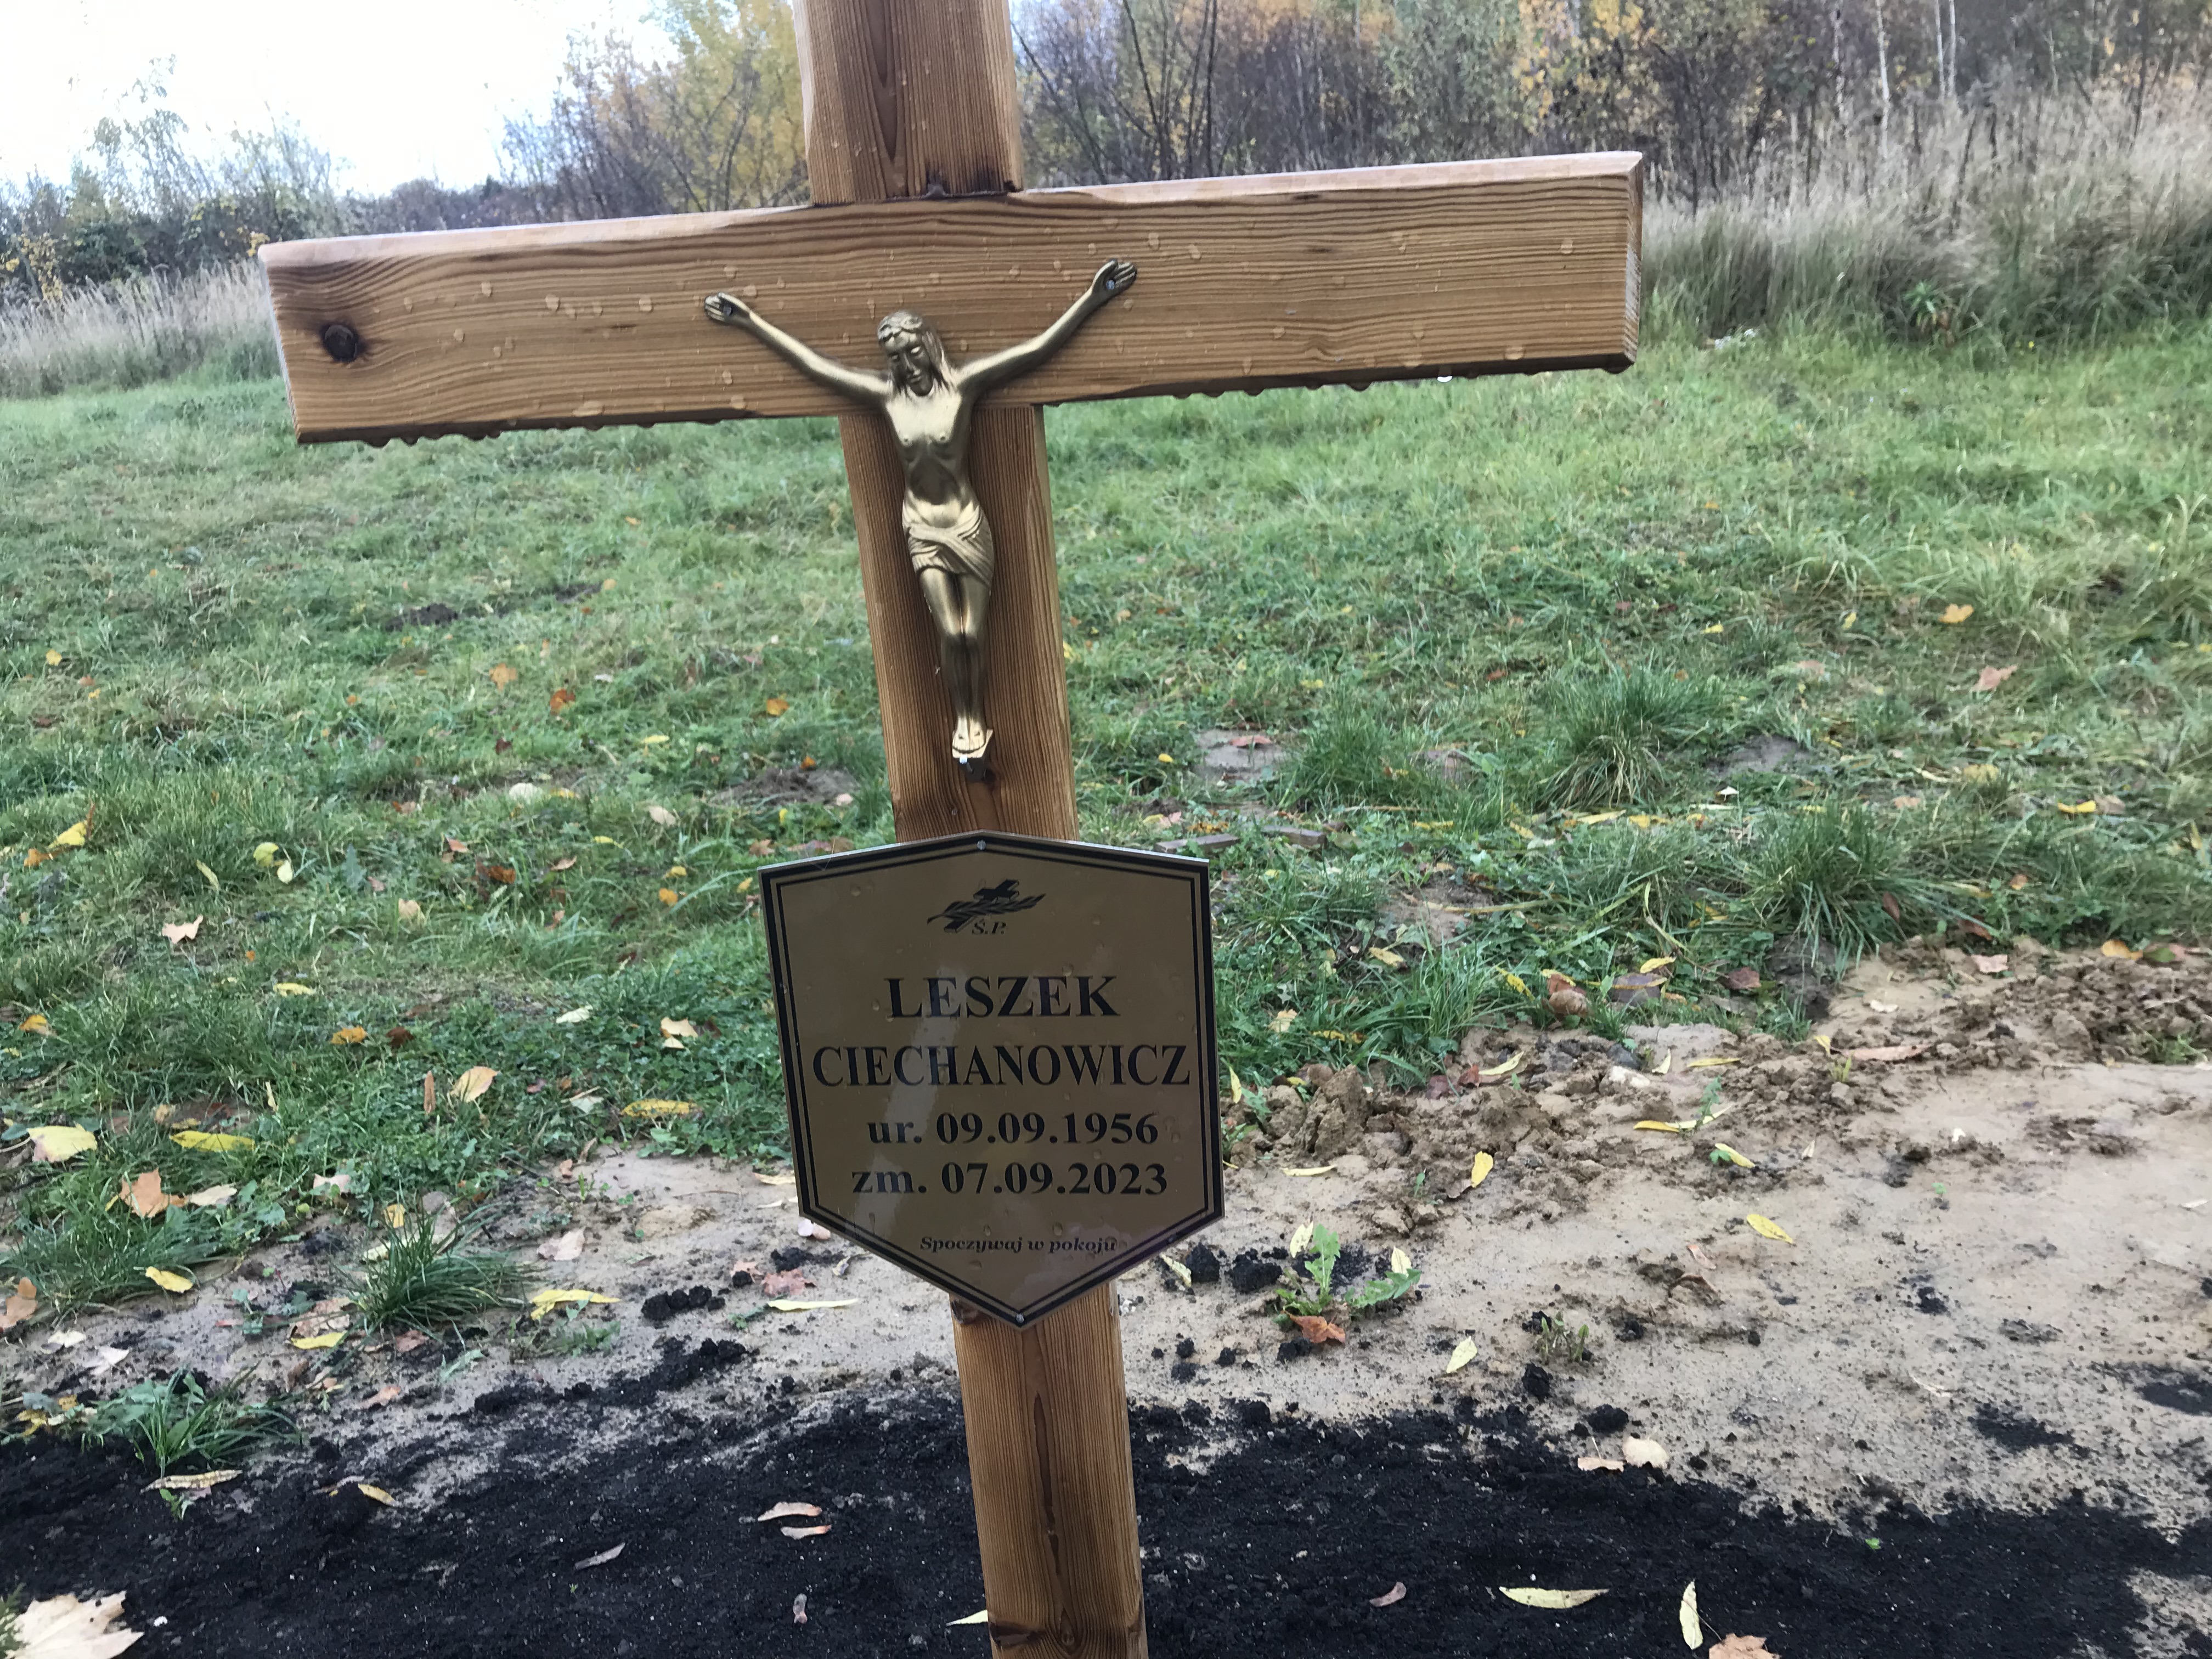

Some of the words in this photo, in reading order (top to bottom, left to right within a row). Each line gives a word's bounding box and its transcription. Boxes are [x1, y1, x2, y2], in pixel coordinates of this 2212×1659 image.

[885, 976, 1120, 1018] LESZEK
[812, 1044, 1191, 1087] CIECHANOWICZ
[867, 1121, 922, 1144] ur.
[936, 1111, 1159, 1144] 09.09.1956
[851, 1170, 927, 1194] zm.
[941, 1161, 1167, 1195] 07.09.2023
[920, 1237, 1023, 1254] Spoczywaj
[1028, 1240, 1044, 1250] w
[1048, 1237, 1117, 1254] pokoju
